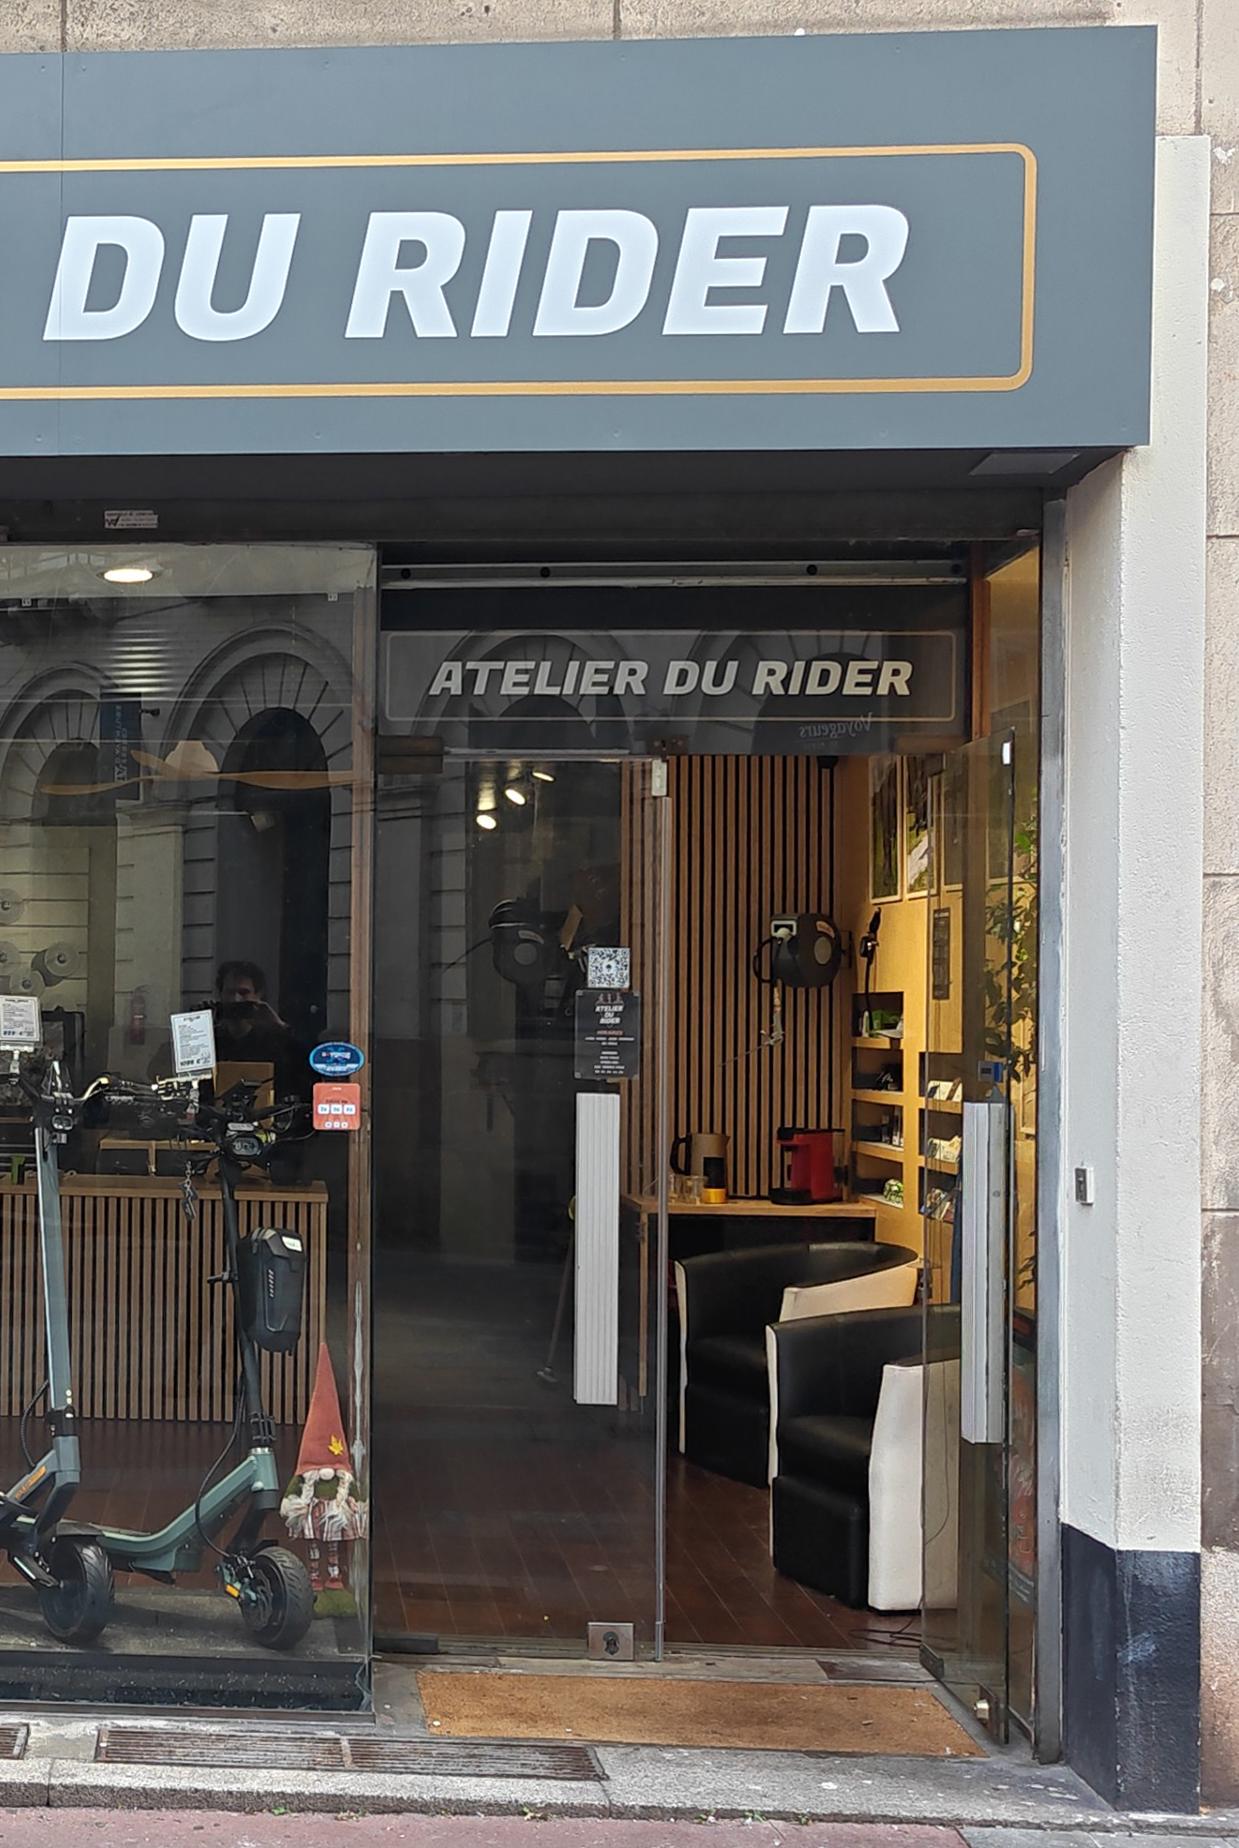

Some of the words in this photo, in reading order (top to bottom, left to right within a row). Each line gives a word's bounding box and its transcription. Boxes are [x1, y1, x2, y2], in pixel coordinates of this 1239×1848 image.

[43, 214, 300, 341] DU
[345, 205, 908, 337] RIDER
[428, 660, 649, 696] ATELIER
[662, 660, 739, 696] DU
[751, 660, 913, 696] RIDER
